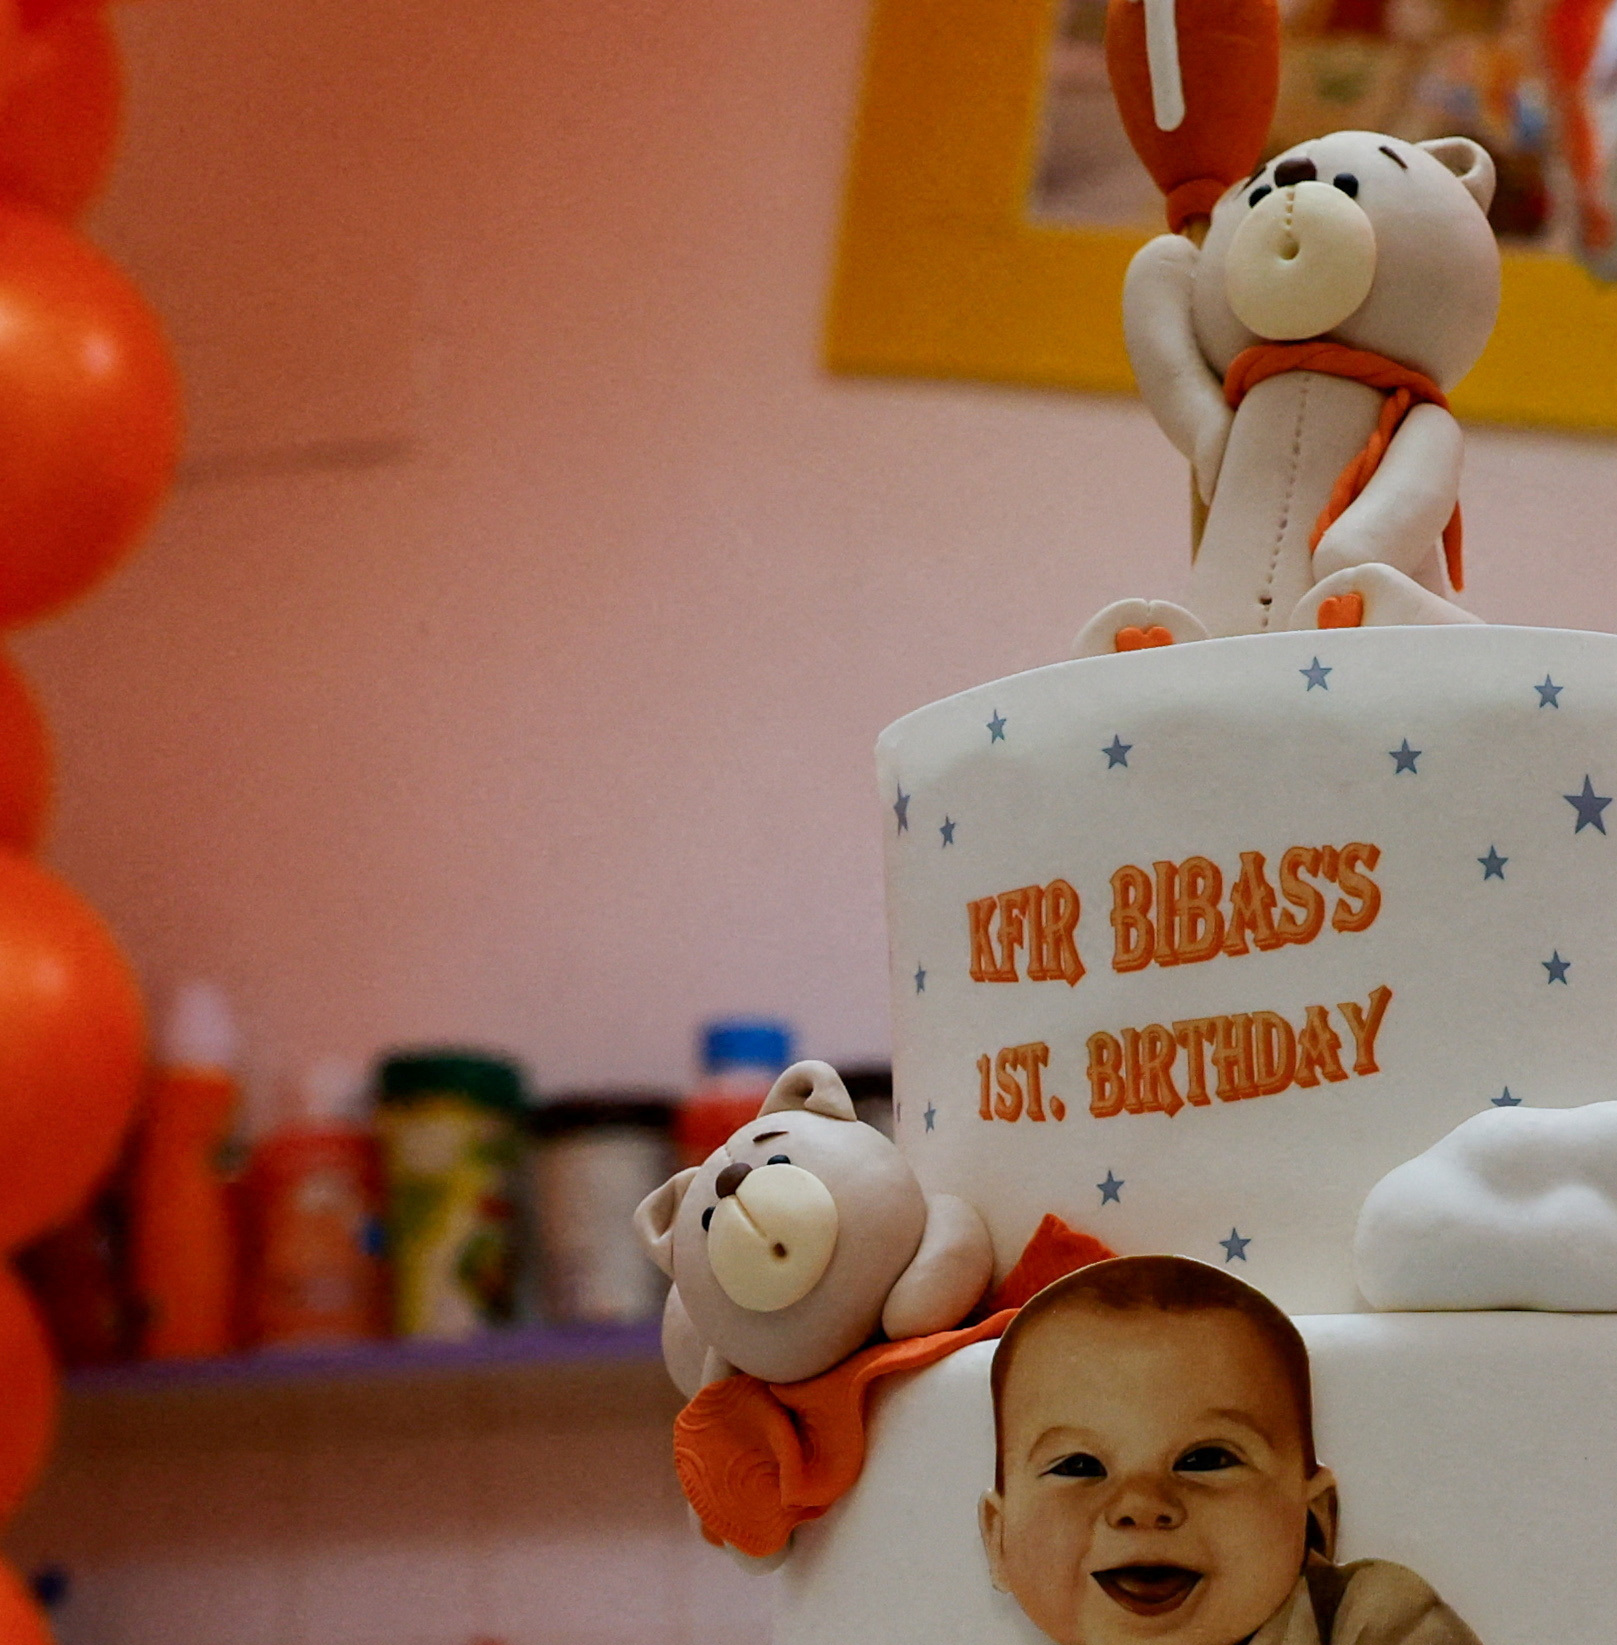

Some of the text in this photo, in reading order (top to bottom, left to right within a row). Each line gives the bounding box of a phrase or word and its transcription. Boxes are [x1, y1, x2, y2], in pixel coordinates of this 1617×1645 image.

[966, 842, 1382, 988] KFIR BIBAS'S
[976, 984, 1393, 1123] 1ST. BIRTHDAY
